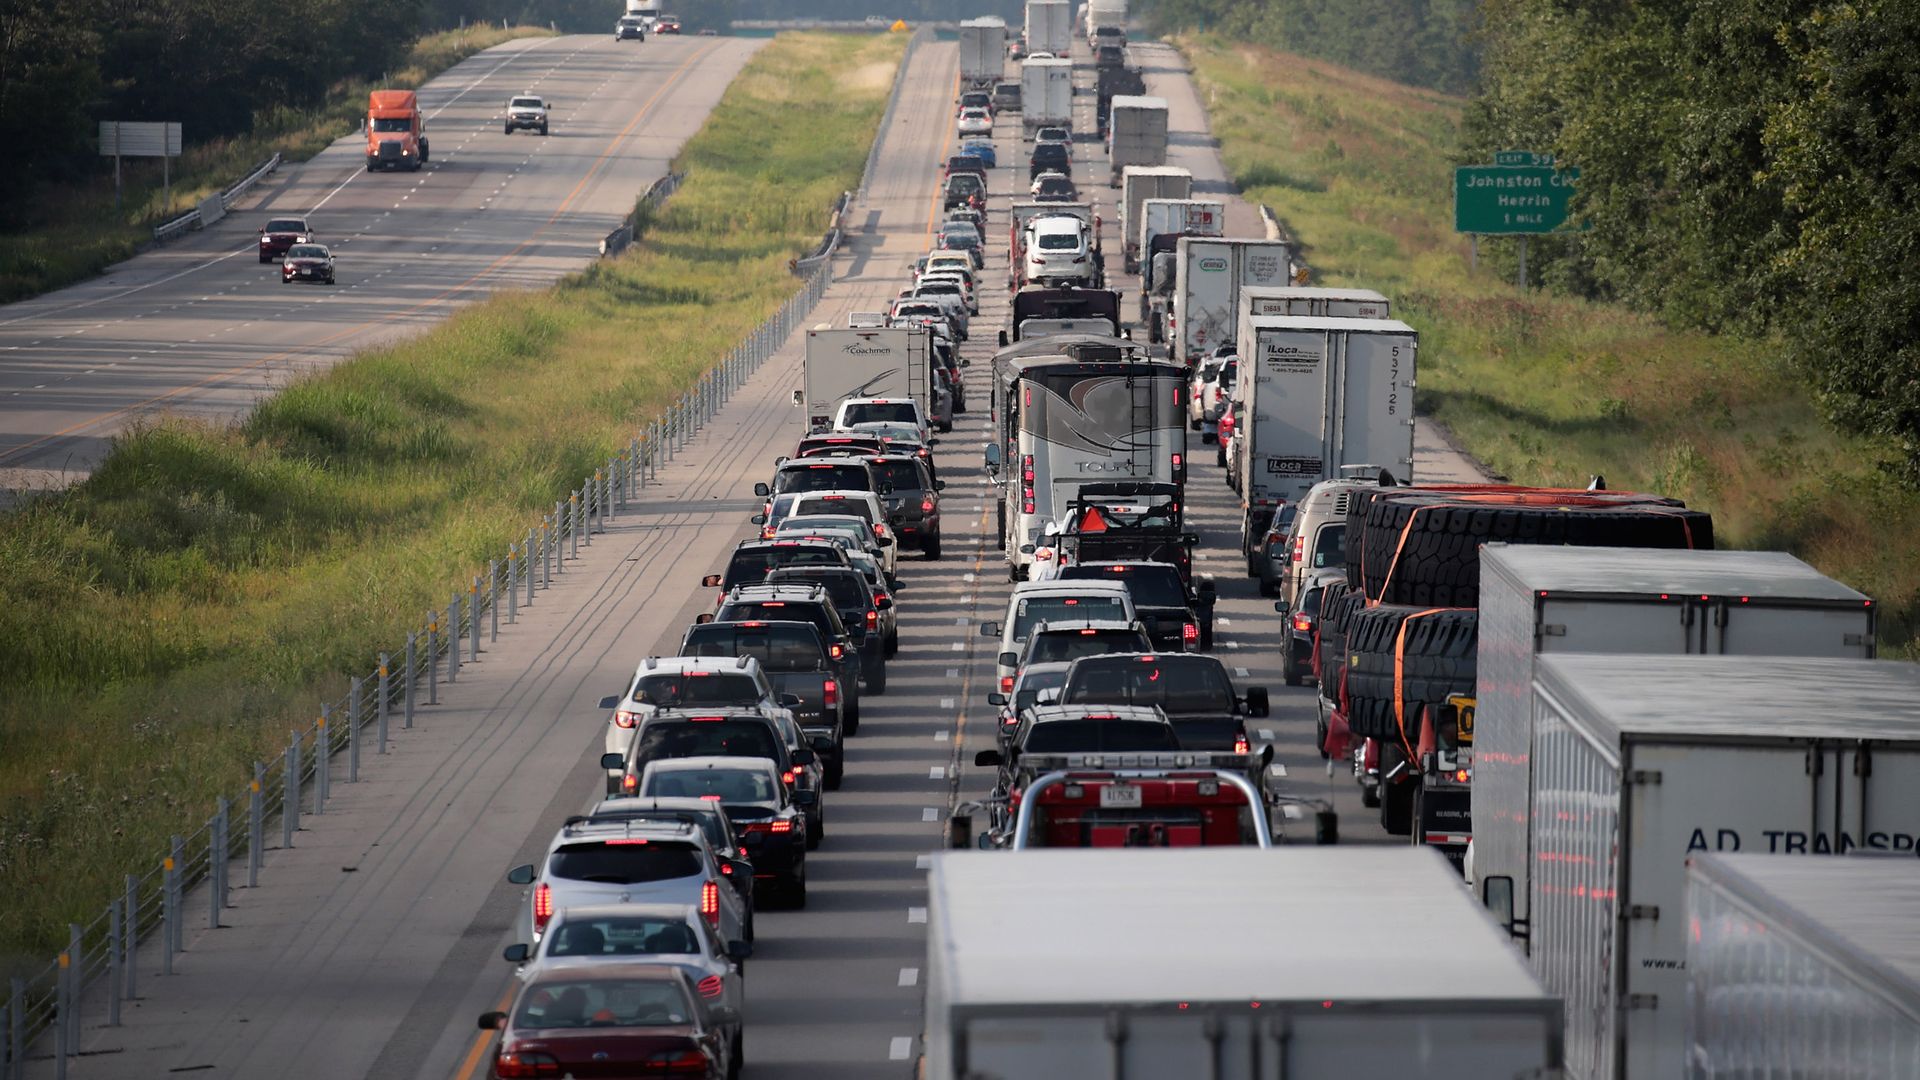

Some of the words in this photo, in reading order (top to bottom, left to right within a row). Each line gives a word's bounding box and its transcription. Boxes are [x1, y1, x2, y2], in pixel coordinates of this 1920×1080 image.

[1466, 175, 1542, 188] Johnston
[1498, 194, 1550, 207] Herrin
[1516, 213, 1543, 223] MILE
[850, 347, 891, 355] Coachmen
[1687, 828, 1741, 854] AD
[1763, 831, 1920, 856] TRANSP
